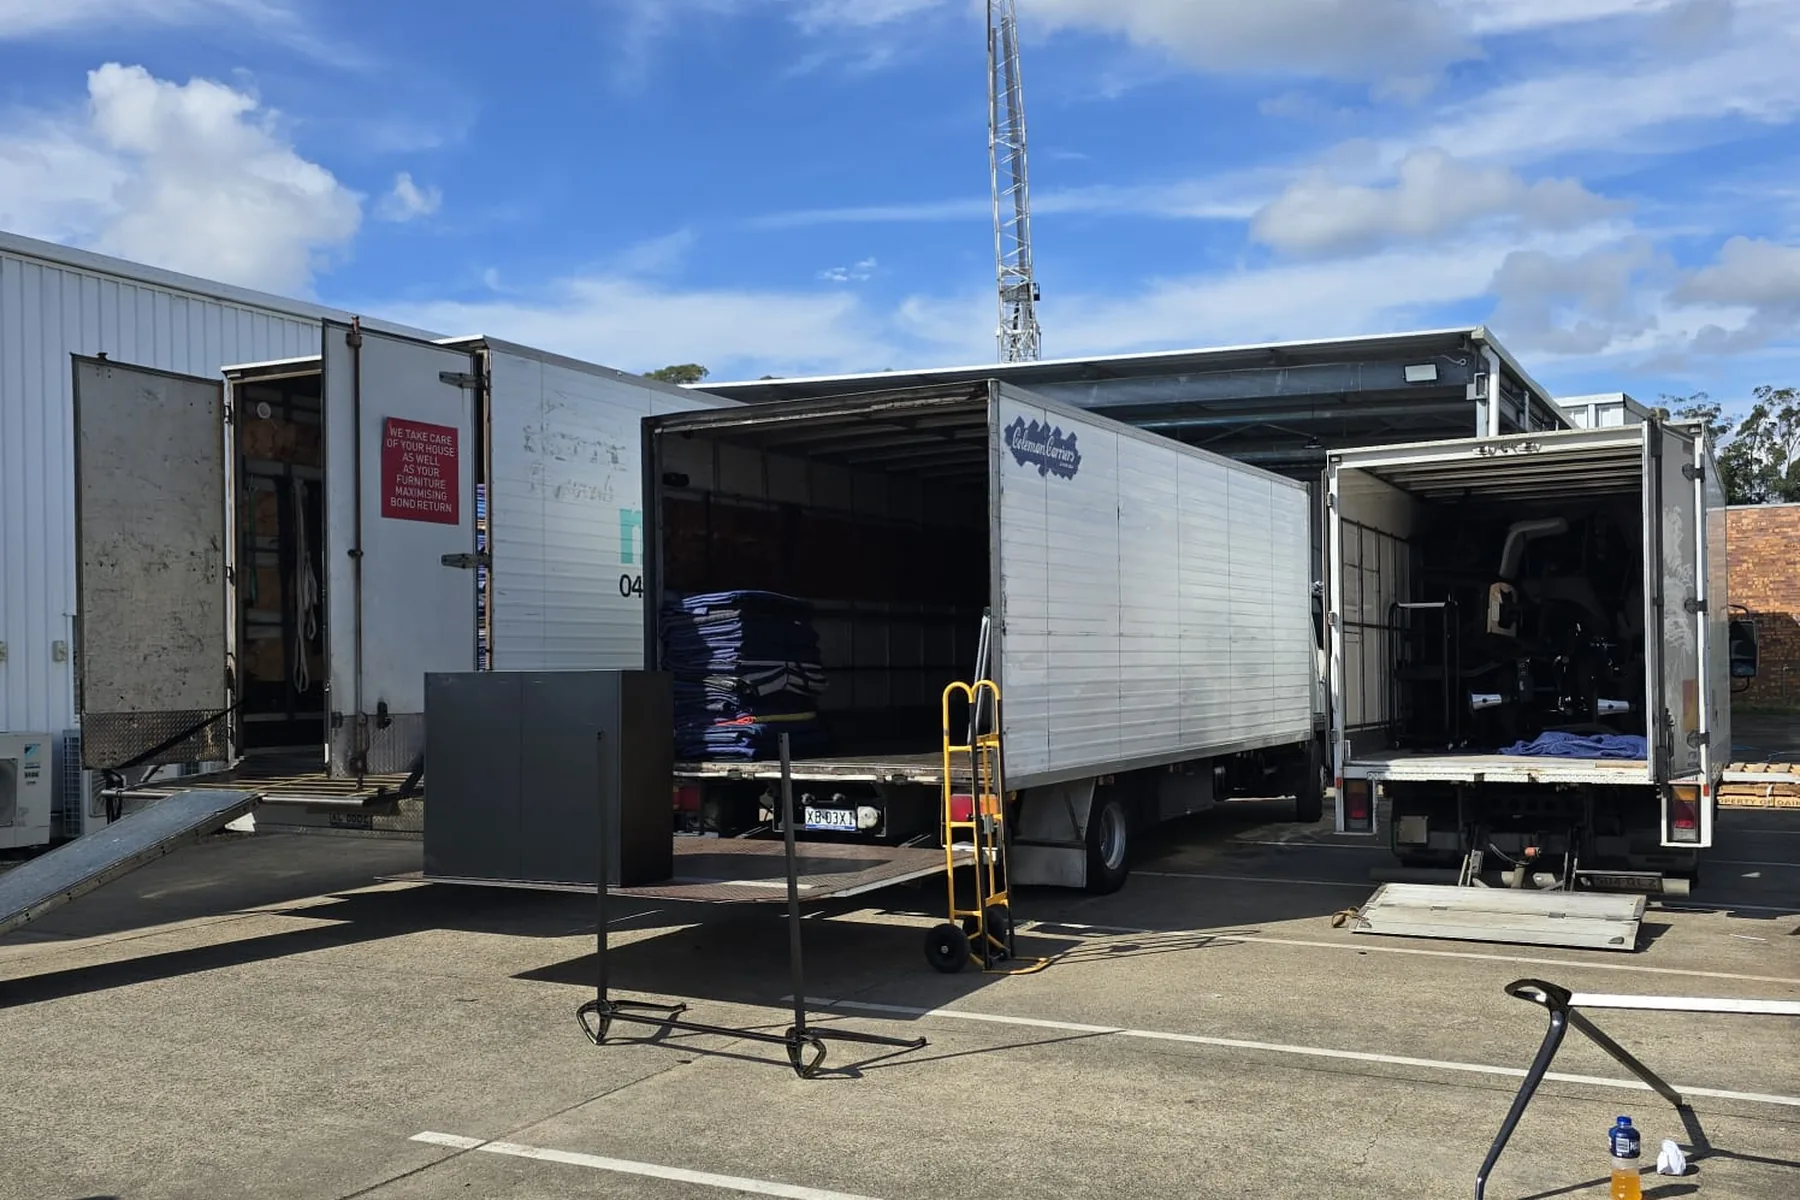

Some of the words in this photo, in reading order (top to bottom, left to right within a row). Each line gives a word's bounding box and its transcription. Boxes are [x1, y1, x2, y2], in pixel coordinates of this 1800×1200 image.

[389, 427, 403, 438] WE
[405, 429, 428, 441] TAKE
[429, 433, 452, 445] CARE
[386, 438, 399, 447] OF
[400, 440, 424, 452] YOUR
[425, 444, 455, 457] HOUSE
[402, 452, 414, 462] AS
[416, 454, 440, 466] WELL
[403, 464, 415, 474] AS
[416, 465, 440, 477] YOUR
[396, 474, 446, 489] FURNITURE
[395, 485, 448, 501] MAXIMISING
[390, 496, 416, 509] BOND
[417, 500, 452, 512] RETURN
